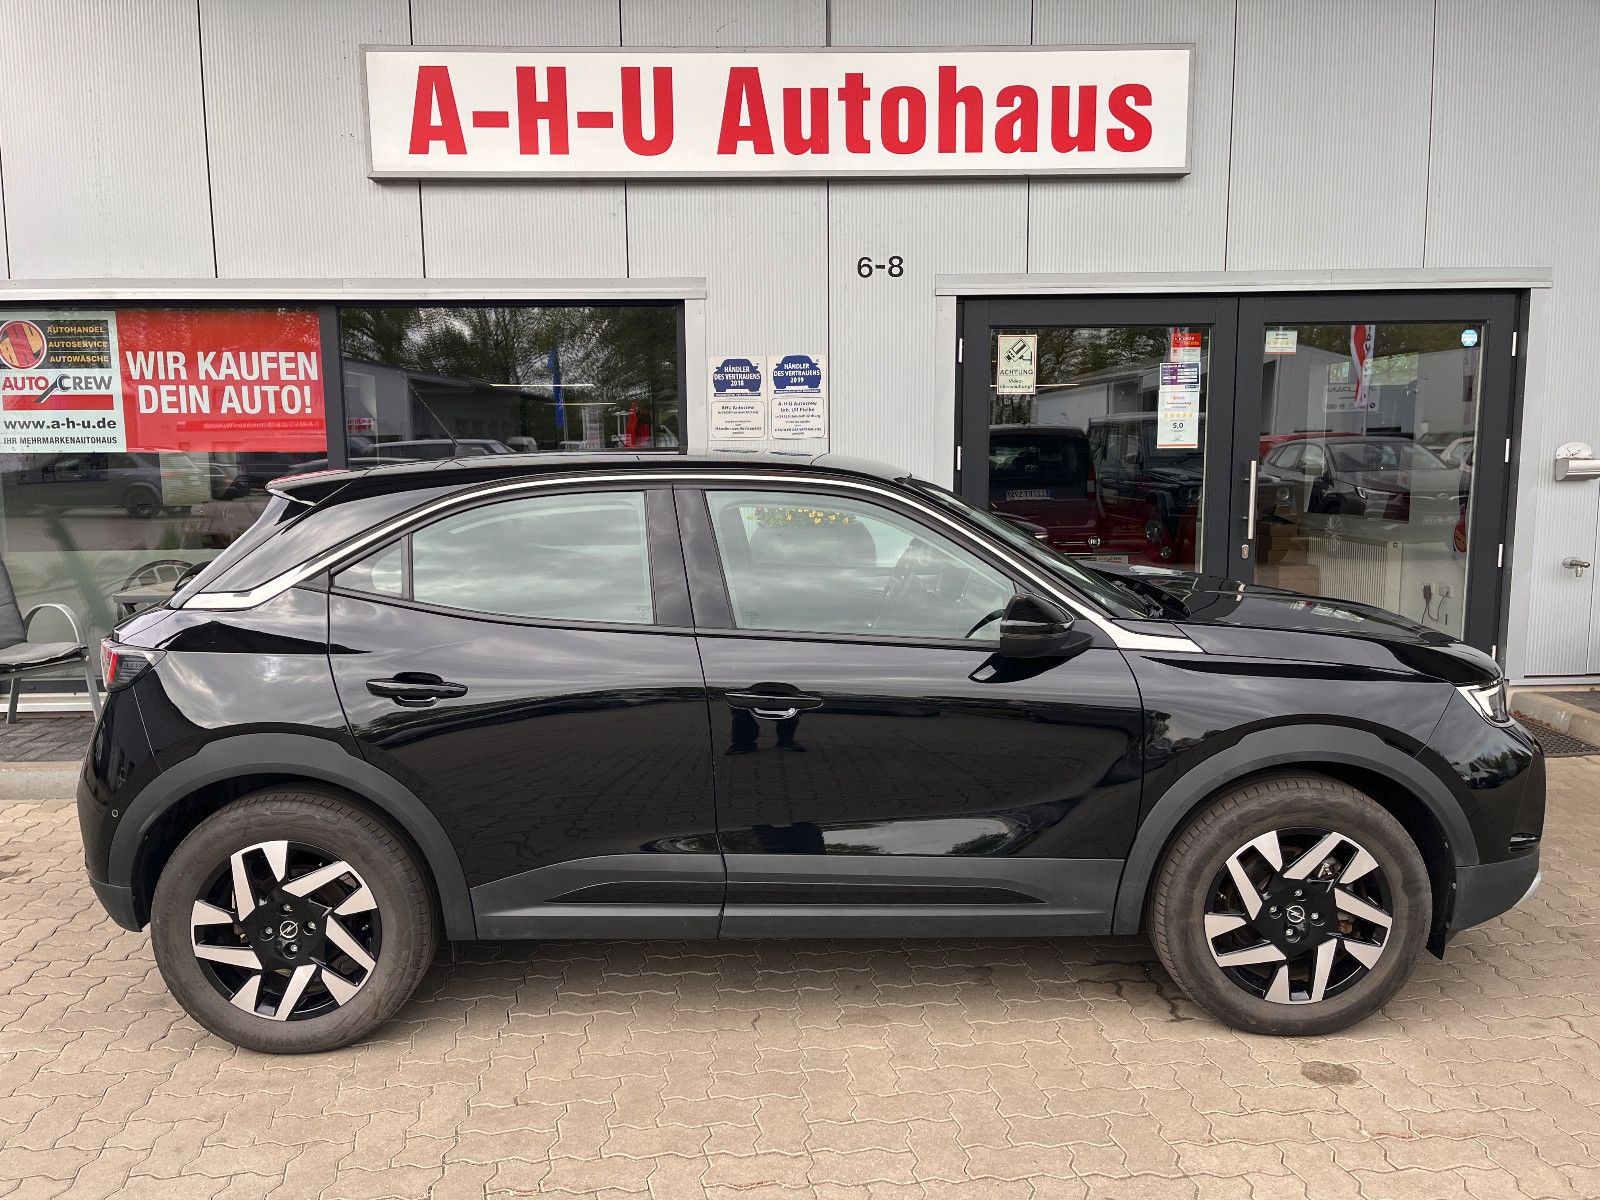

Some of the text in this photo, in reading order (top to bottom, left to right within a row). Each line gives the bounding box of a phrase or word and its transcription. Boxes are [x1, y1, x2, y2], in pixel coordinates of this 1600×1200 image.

[408, 66, 1153, 157] A-H-U Autohaus
[857, 255, 904, 278] 6-8
[47, 325, 106, 335] AUTOHANDEL
[48, 340, 109, 350] AUTOSERVICE
[49, 353, 110, 364] AUTOWÄSCHE
[125, 351, 319, 381] WIR KAUFEN
[724, 365, 750, 373] HÄNDLER
[714, 373, 761, 381] DES VERTRAUENS
[785, 369, 820, 377] VERTRAUENS
[1, 374, 113, 392] AUTO CREW
[137, 384, 312, 415] DEIN AUTO!
[3, 417, 117, 430] www.a-h-u.de
[3, 436, 118, 445] IHR MEHRMARKENAUTOHAUS
